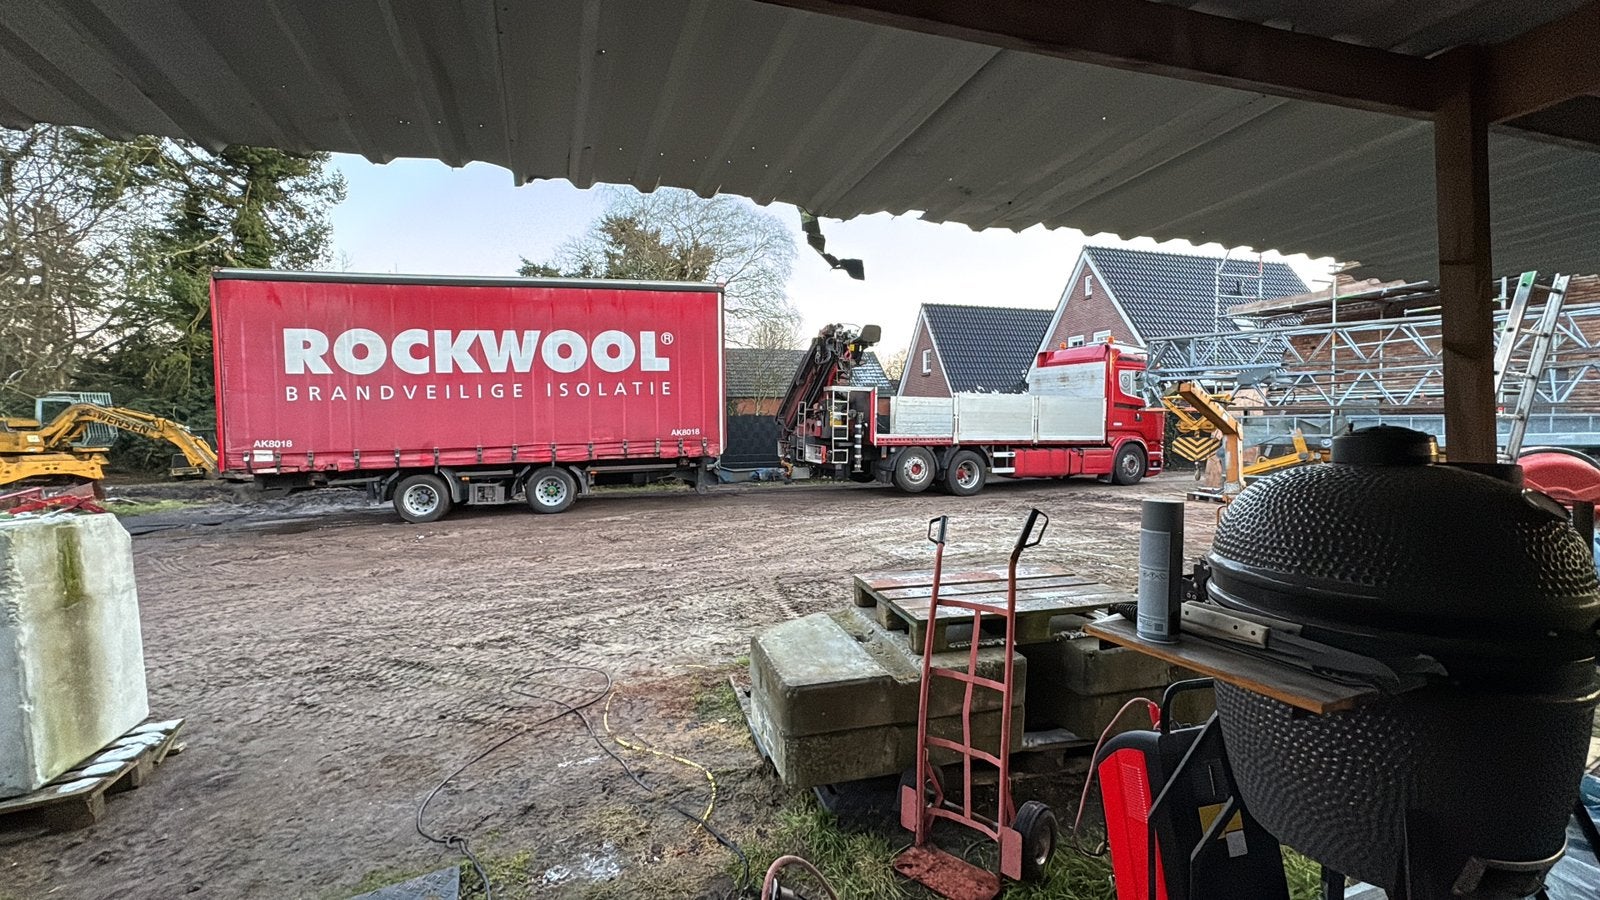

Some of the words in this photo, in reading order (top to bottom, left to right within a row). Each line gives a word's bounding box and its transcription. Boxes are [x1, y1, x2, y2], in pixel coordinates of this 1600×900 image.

[285, 384, 523, 402] BRANDVEILIGE
[547, 382, 671, 398] ISOLATIE
[671, 428, 700, 436] AK8018
[253, 440, 293, 448] AK8018
